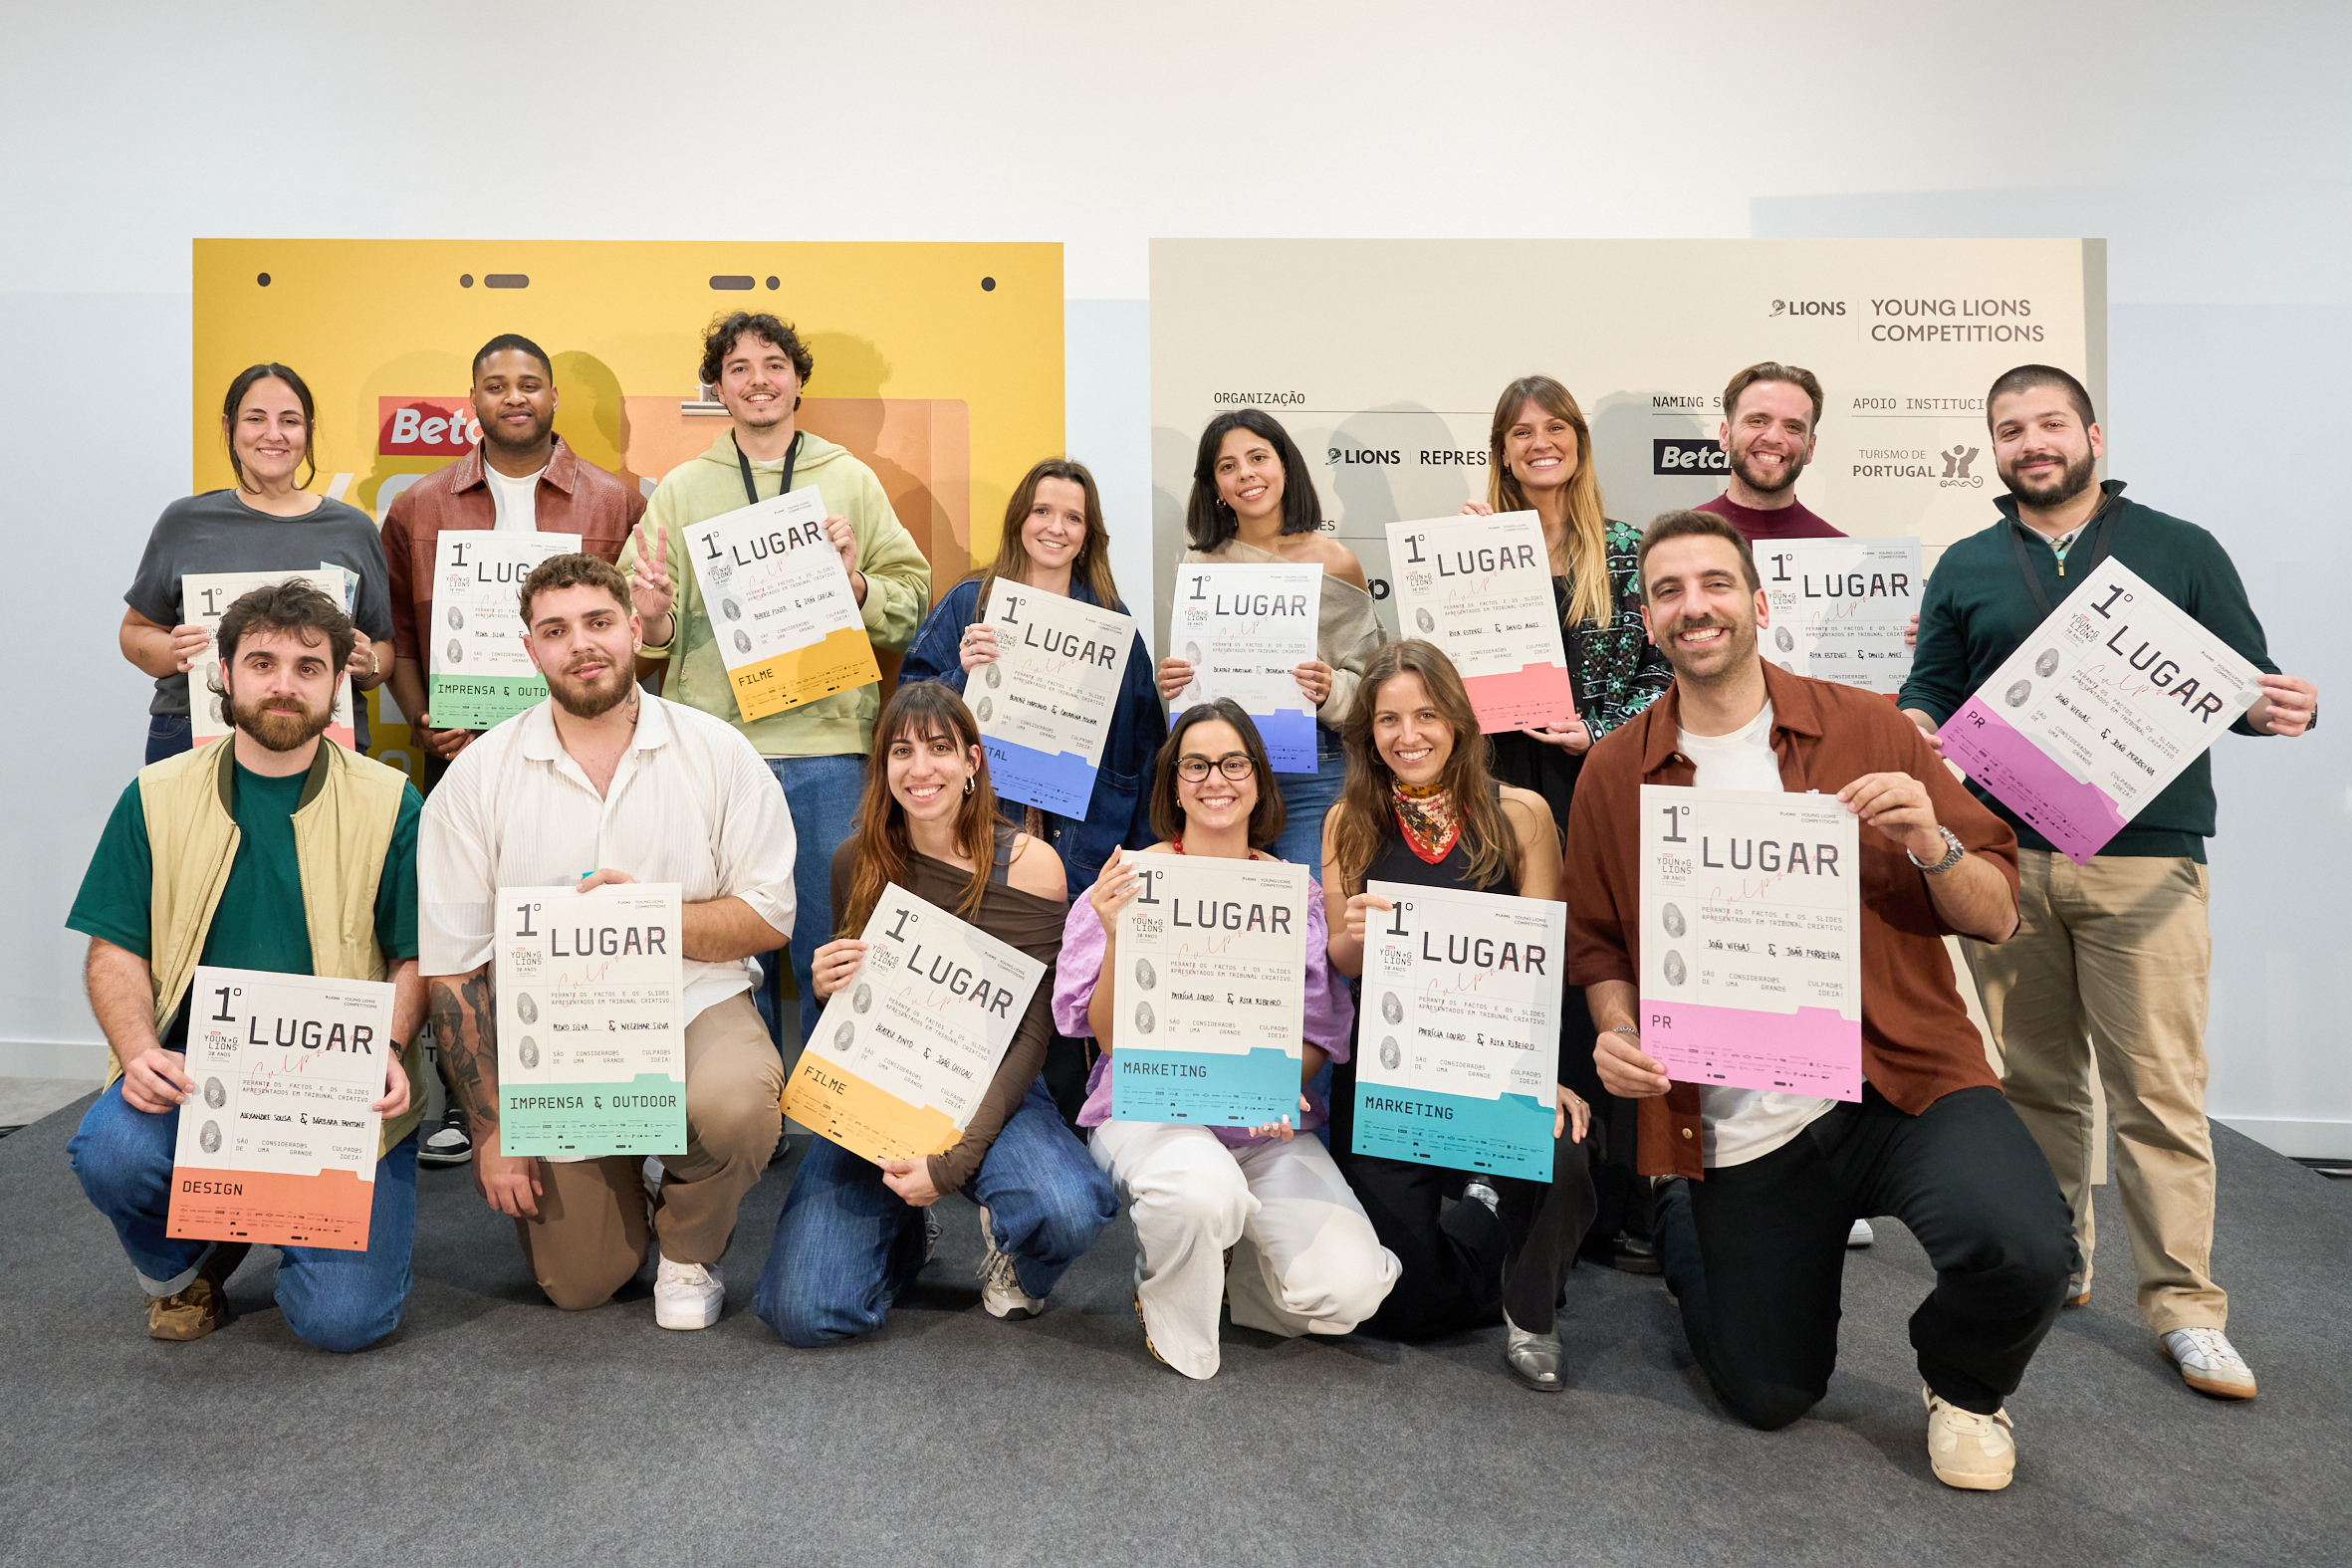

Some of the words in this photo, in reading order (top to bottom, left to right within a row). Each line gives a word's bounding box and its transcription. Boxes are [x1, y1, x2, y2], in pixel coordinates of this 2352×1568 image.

[1789, 302, 1846, 316] LIONS
[1871, 300, 1957, 317] YOUNG
[1963, 300, 2031, 317] LIONS
[1871, 325, 2044, 342] COMPETITIONS
[1214, 390, 1305, 406] ORGANIZAÇÃO
[1653, 396, 1704, 407] NAMING
[1852, 398, 1897, 409] APOIO
[1906, 398, 1985, 410] INSTITUCI
[390, 408, 484, 445] Betc
[1345, 450, 1401, 465] LIONS
[1661, 446, 1733, 469] Betcl
[1859, 449, 1909, 460] TURISMO
[1912, 450, 1926, 460] DE
[1853, 465, 1936, 478] PORTUGAL
[732, 521, 823, 566] LUGAR
[1437, 544, 1535, 576] LUGAR
[478, 561, 531, 583] LUG
[1803, 572, 1909, 597] LUGAR
[1215, 594, 1305, 616] LUGAR
[2069, 621, 2095, 642] LIONS
[1024, 622, 1115, 670] LUGAR
[738, 668, 774, 686] FILME
[2105, 624, 2223, 724] LUGAR
[437, 684, 495, 695] IMPRENSA
[503, 686, 510, 696] &
[1966, 710, 1986, 728] PR
[1703, 835, 1839, 876] LUGAR
[1662, 865, 1692, 874] LIONS
[1173, 898, 1291, 934] LUGAR
[551, 926, 666, 957] LUGAR
[1422, 931, 1545, 976] LUGAR
[906, 944, 1013, 1018] LUGAR
[1652, 1014, 1671, 1028] PR
[248, 1015, 372, 1054] LUGAR
[1123, 1061, 1206, 1077] MARKETING
[804, 1065, 846, 1095] FILME
[510, 1096, 584, 1109] IMPRENSA
[593, 1096, 601, 1109] &
[612, 1095, 676, 1107] OUTDOOR
[1365, 1095, 1453, 1119] MARKETING
[182, 1180, 243, 1196] DESIGN
